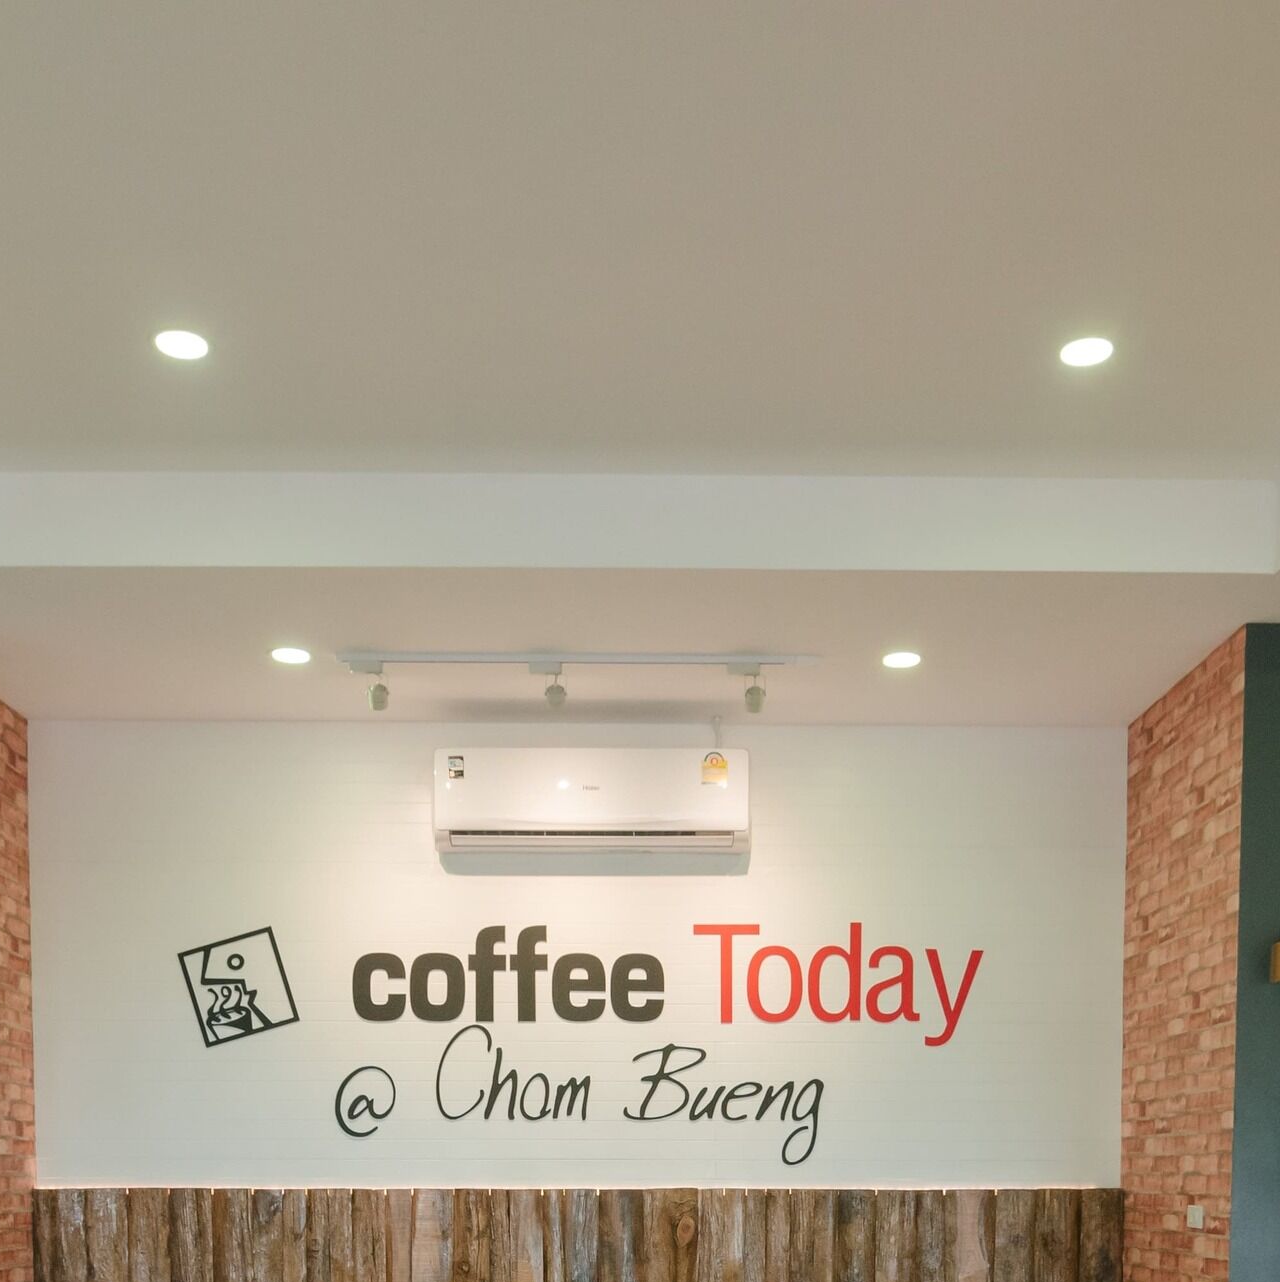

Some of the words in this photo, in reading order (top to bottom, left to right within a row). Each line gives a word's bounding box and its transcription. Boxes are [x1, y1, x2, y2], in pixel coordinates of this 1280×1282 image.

[352, 925, 665, 1022] coffee
[692, 921, 984, 1047] Today
[334, 1065, 396, 1138] @
[435, 1024, 591, 1121] Cham
[623, 1043, 825, 1166] Bueng
